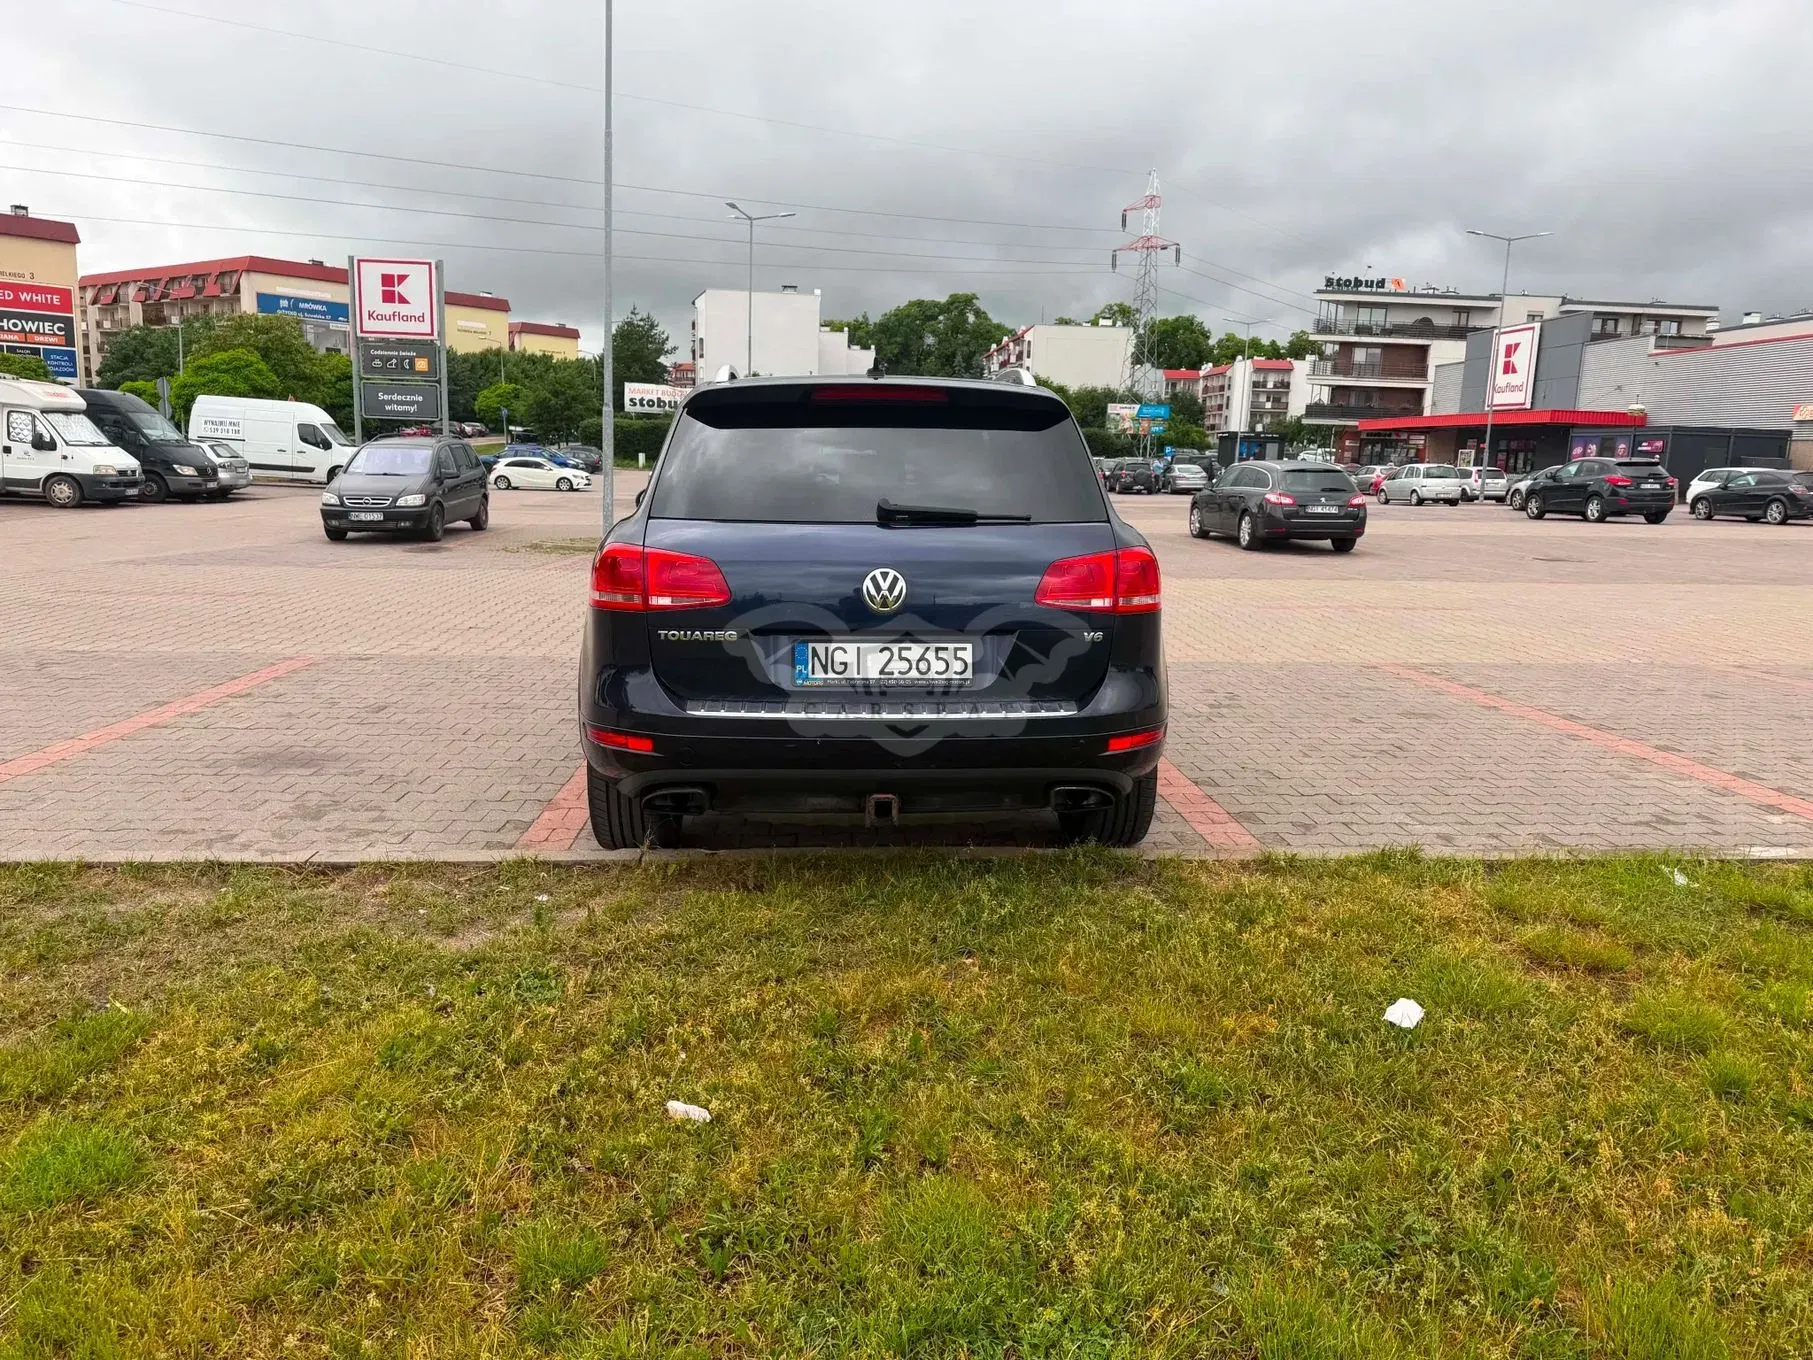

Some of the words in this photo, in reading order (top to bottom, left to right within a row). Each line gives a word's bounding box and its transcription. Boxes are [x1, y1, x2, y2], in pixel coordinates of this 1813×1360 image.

[29, 272, 35, 280] 3
[1325, 276, 1386, 289] stobud
[19, 291, 61, 305] WHITE
[299, 302, 328, 312] MRÓWKA
[367, 310, 425, 323] Kaufland
[628, 387, 659, 395] MARKET
[378, 392, 423, 402] Serdecznie
[385, 404, 417, 413] witamy!
[657, 629, 738, 641] TOUAREG
[1083, 630, 1104, 643] V6
[811, 646, 861, 676] NGI
[878, 646, 969, 676] 25655
[796, 665, 807, 673] PL
